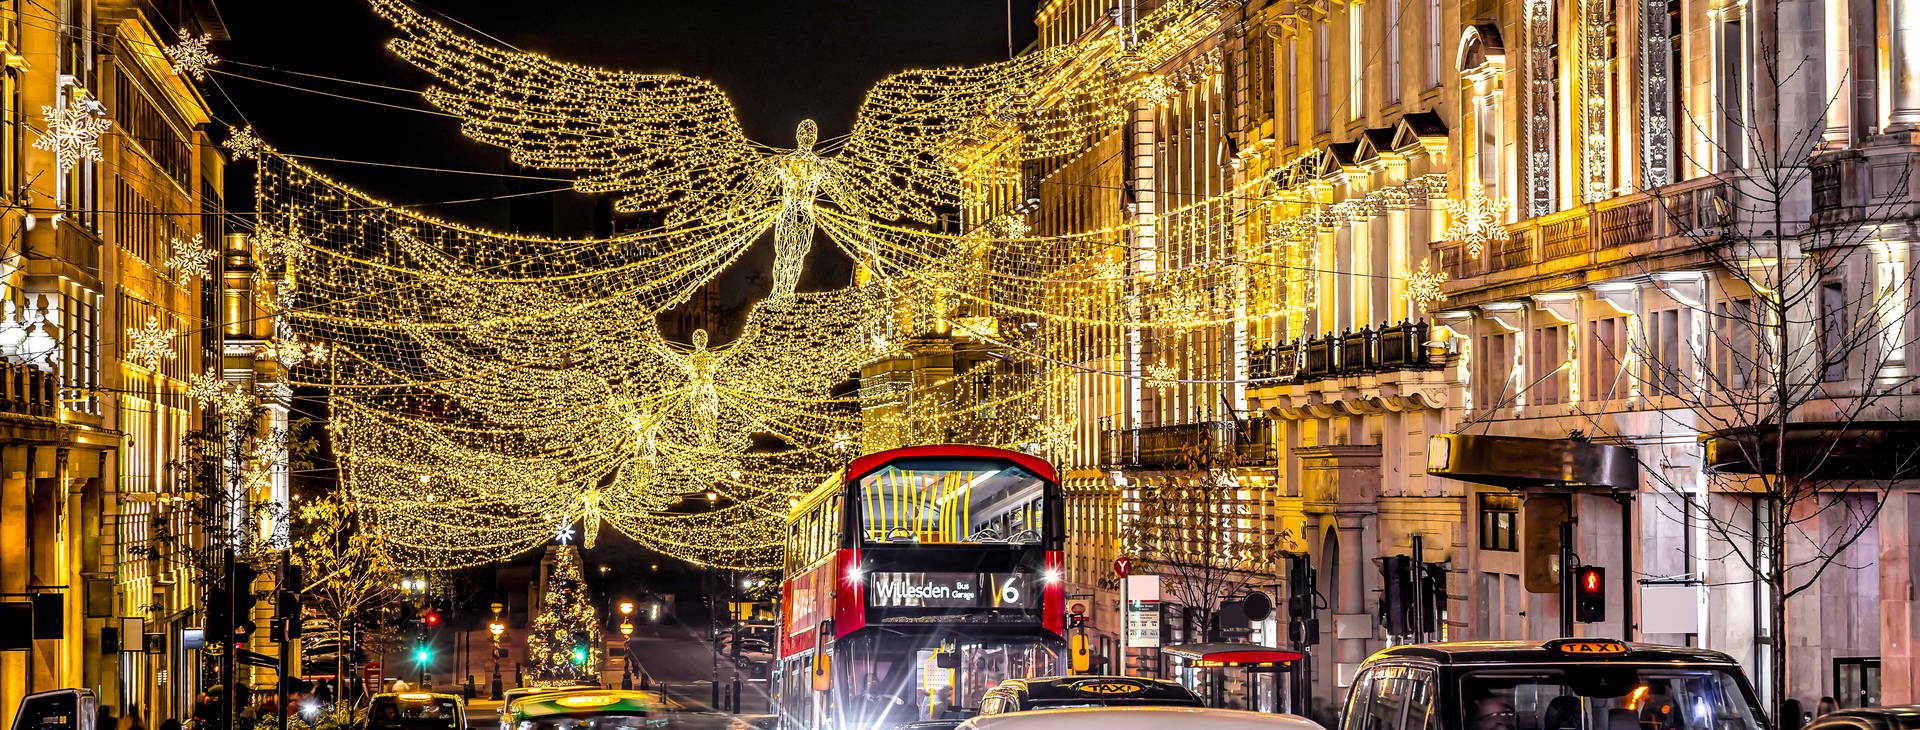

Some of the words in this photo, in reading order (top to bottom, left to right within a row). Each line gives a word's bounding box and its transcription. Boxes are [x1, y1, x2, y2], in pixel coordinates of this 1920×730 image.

[1118, 560, 1127, 572] Y
[876, 581, 950, 598] Willesden
[956, 582, 969, 590] Bus
[951, 590, 974, 600] Garage
[1566, 644, 1620, 652] TAXI
[1088, 684, 1131, 692] TAXI
